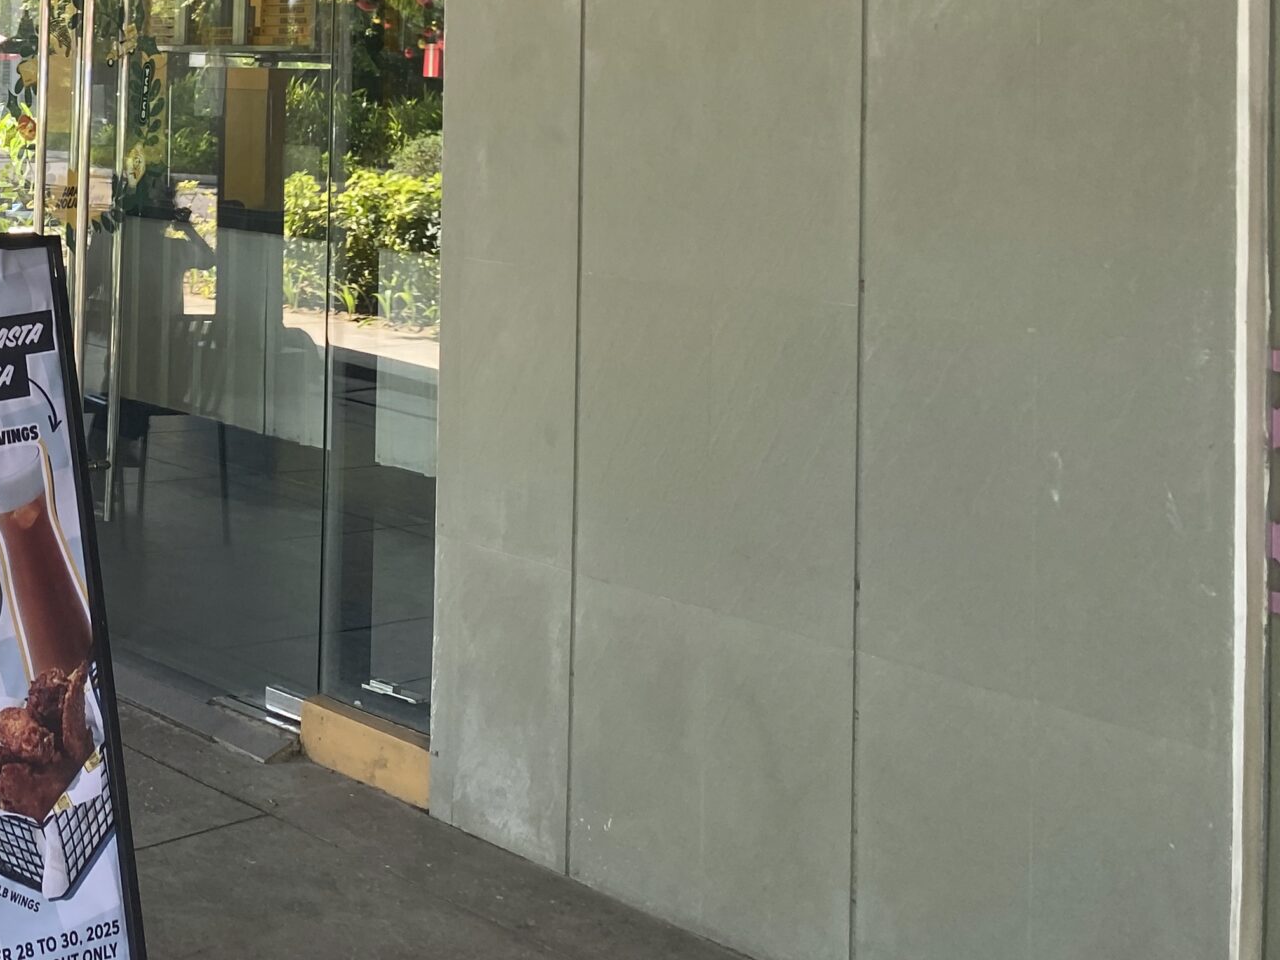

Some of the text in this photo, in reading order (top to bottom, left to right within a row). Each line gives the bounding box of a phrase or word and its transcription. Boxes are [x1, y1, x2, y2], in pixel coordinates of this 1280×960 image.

[9, 891, 41, 913] WINGS
[16, 942, 35, 960] 28
[37, 936, 57, 955] TO
[60, 930, 84, 949] 30,
[86, 920, 120, 942] 2025
[82, 942, 118, 960] ONLY
